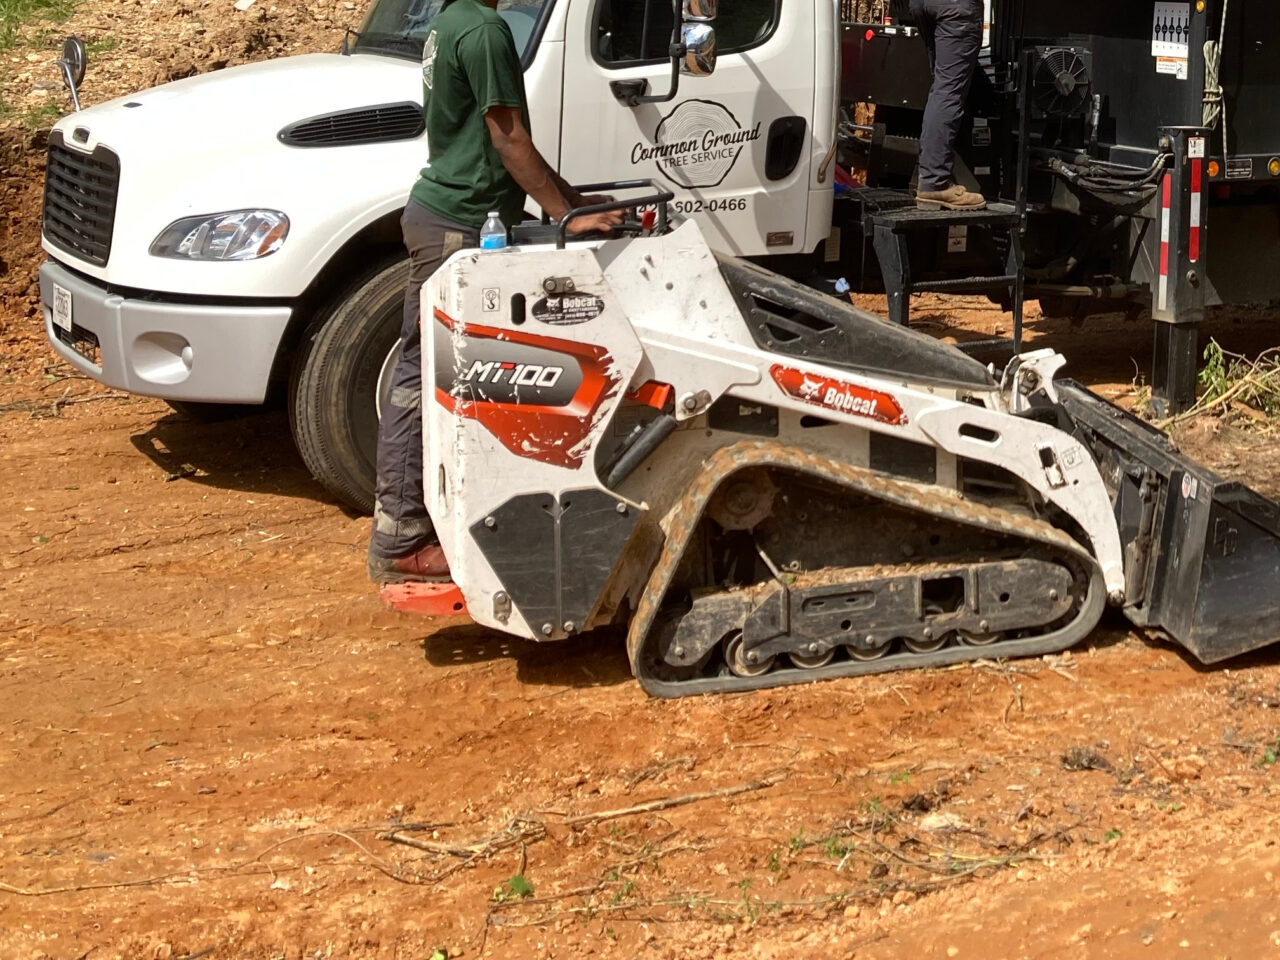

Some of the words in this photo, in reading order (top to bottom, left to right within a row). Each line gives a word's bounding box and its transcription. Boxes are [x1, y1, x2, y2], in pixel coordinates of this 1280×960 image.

[631, 141, 699, 165] Common
[701, 121, 762, 152] Ground
[662, 155, 689, 169] TREE
[690, 147, 735, 164] SERVICE
[562, 297, 597, 309] Bobcat
[464, 360, 564, 388] MT100
[823, 386, 878, 416] Bobcat
